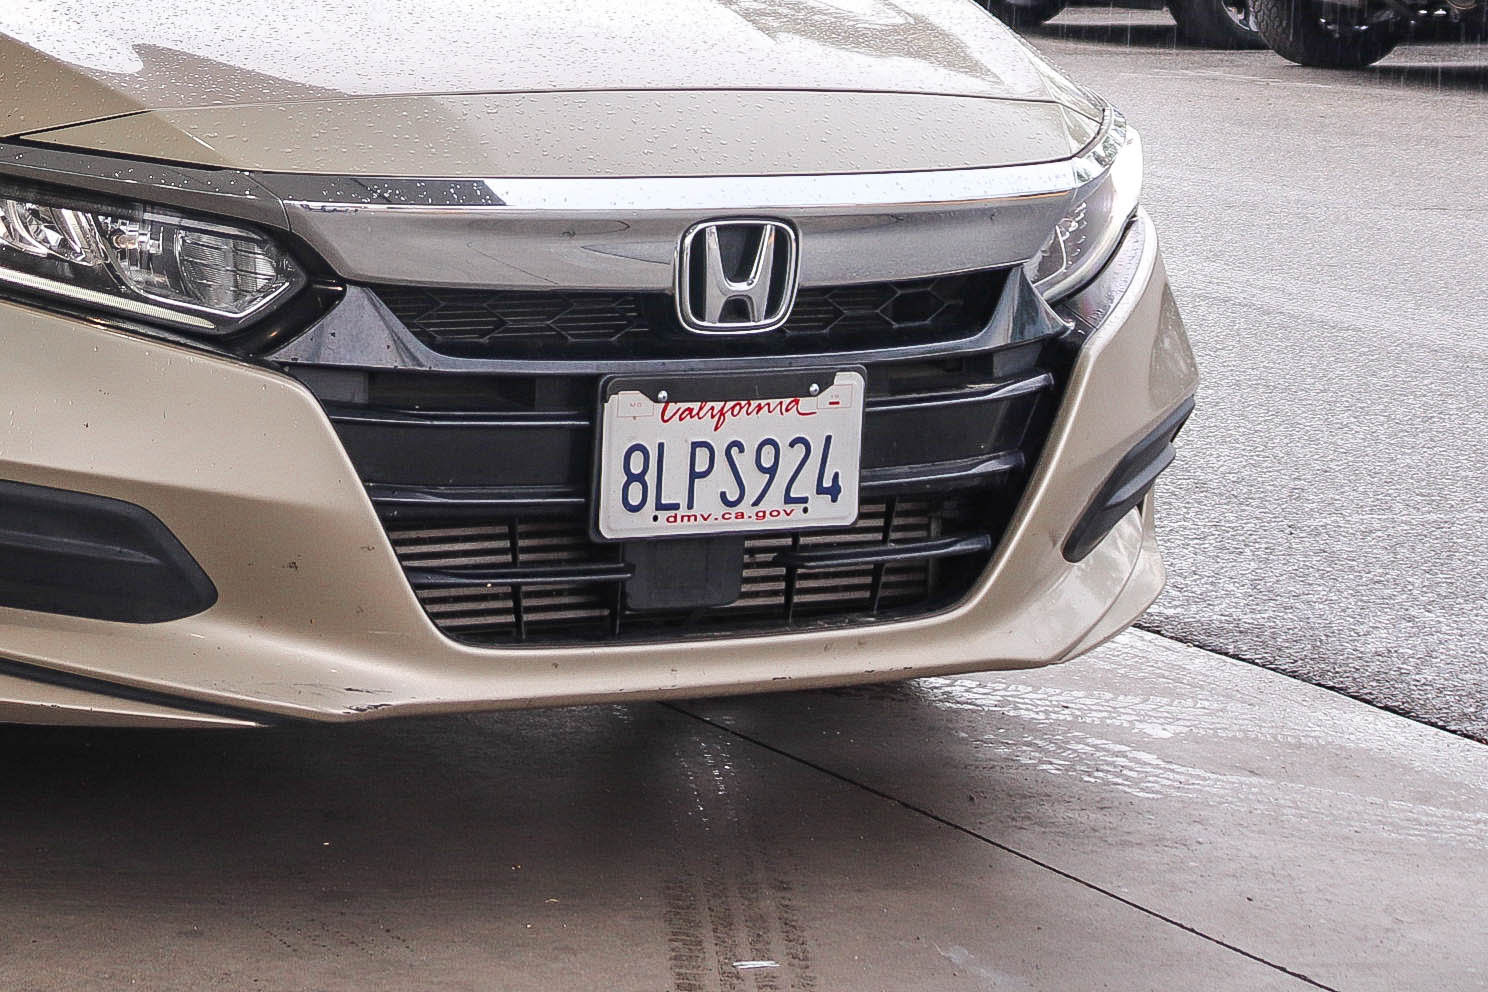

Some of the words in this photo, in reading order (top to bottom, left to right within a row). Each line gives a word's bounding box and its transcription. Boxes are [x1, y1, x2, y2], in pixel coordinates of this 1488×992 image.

[660, 397, 817, 431] California
[621, 434, 842, 513] 8LPS924
[665, 508, 795, 524] dmv.ca.gov
